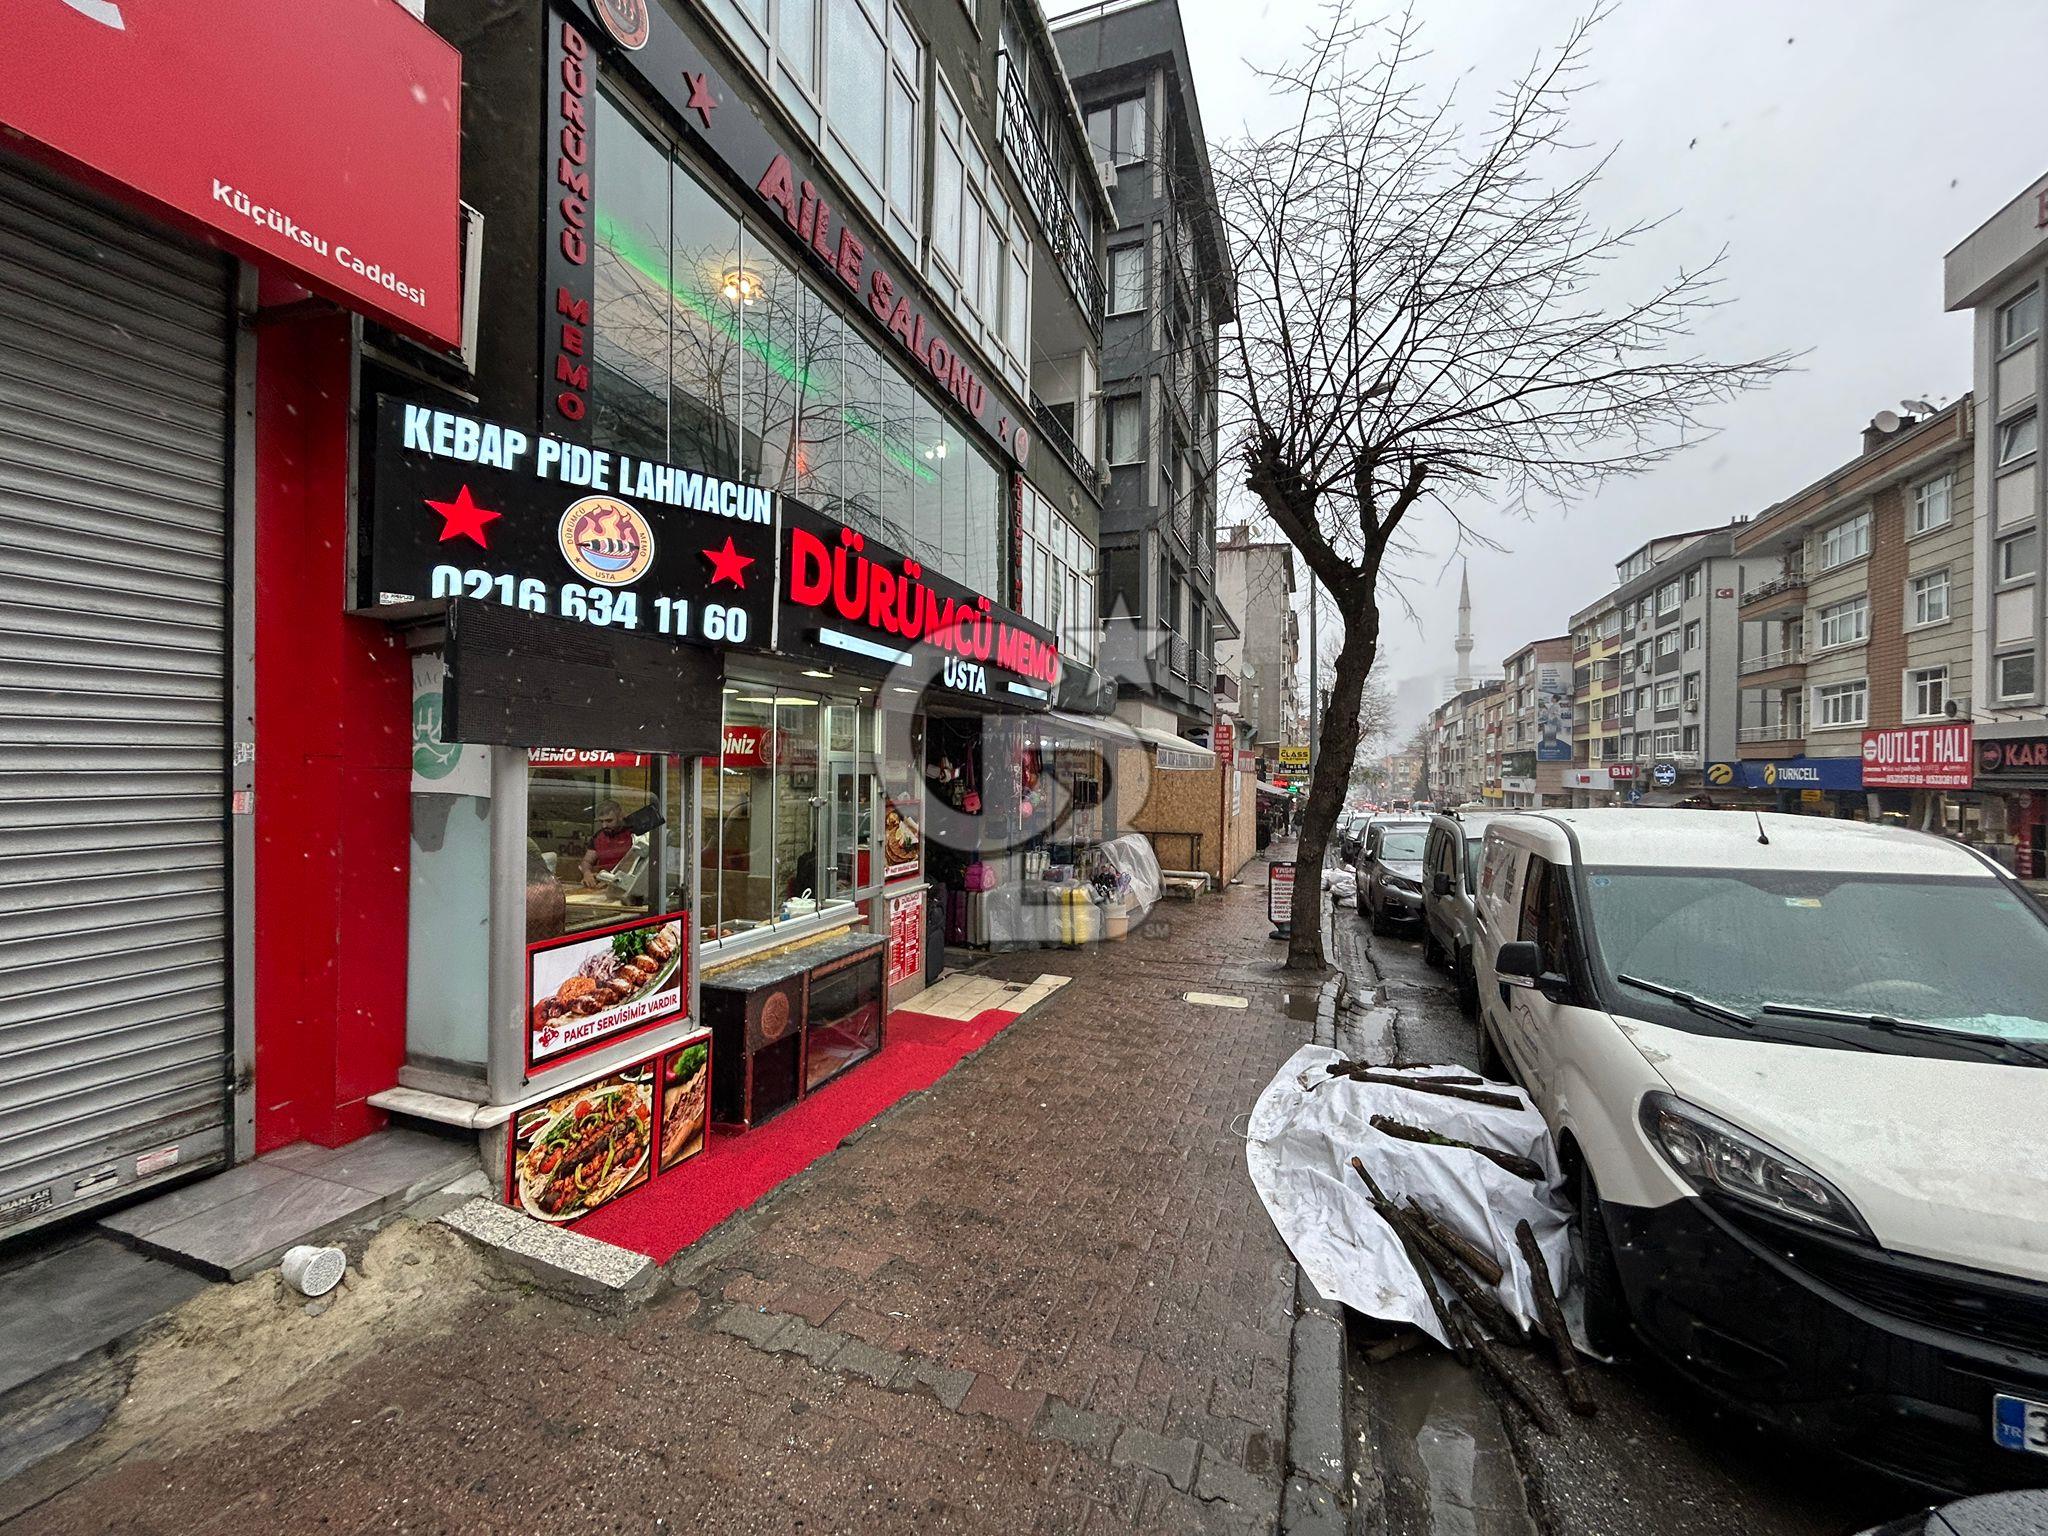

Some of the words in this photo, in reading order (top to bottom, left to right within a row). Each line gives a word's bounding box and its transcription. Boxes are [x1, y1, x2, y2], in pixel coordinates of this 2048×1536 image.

[557, 22, 590, 266] DÜRÜMCÜ
[212, 178, 328, 257] Küçüksu
[335, 246, 426, 307] Caddesi
[756, 153, 865, 294] AİLE
[867, 269, 987, 420] SALONU
[556, 286, 591, 421] MEMO
[403, 404, 528, 471] KEBAP
[536, 433, 609, 491] PİDE
[619, 456, 771, 526] LAHMACUN
[564, 507, 587, 546] DÜRÜMCÜ
[639, 532, 648, 558] MEMO
[595, 571, 616, 581] USTA
[431, 565, 547, 614] 0216
[560, 583, 638, 630] 634
[654, 596, 689, 636] 11
[703, 604, 748, 643] 60
[790, 527, 992, 661] DÜRÜMCÜ
[997, 621, 1059, 684] MEMO
[943, 656, 987, 695] USTA
[528, 747, 576, 763] MEMO
[579, 749, 616, 763] USTA
[1878, 730, 1929, 763] OUTLET
[1933, 728, 1969, 763] HALI
[1612, 766, 1635, 776] BİM
[1777, 767, 1820, 781] TURKCELL
[563, 1022, 595, 1043] PAKET
[597, 1002, 646, 1032] SERVİSİMİZ
[647, 994, 678, 1013] VARDIR
[2001, 1423, 2022, 1438] TR
